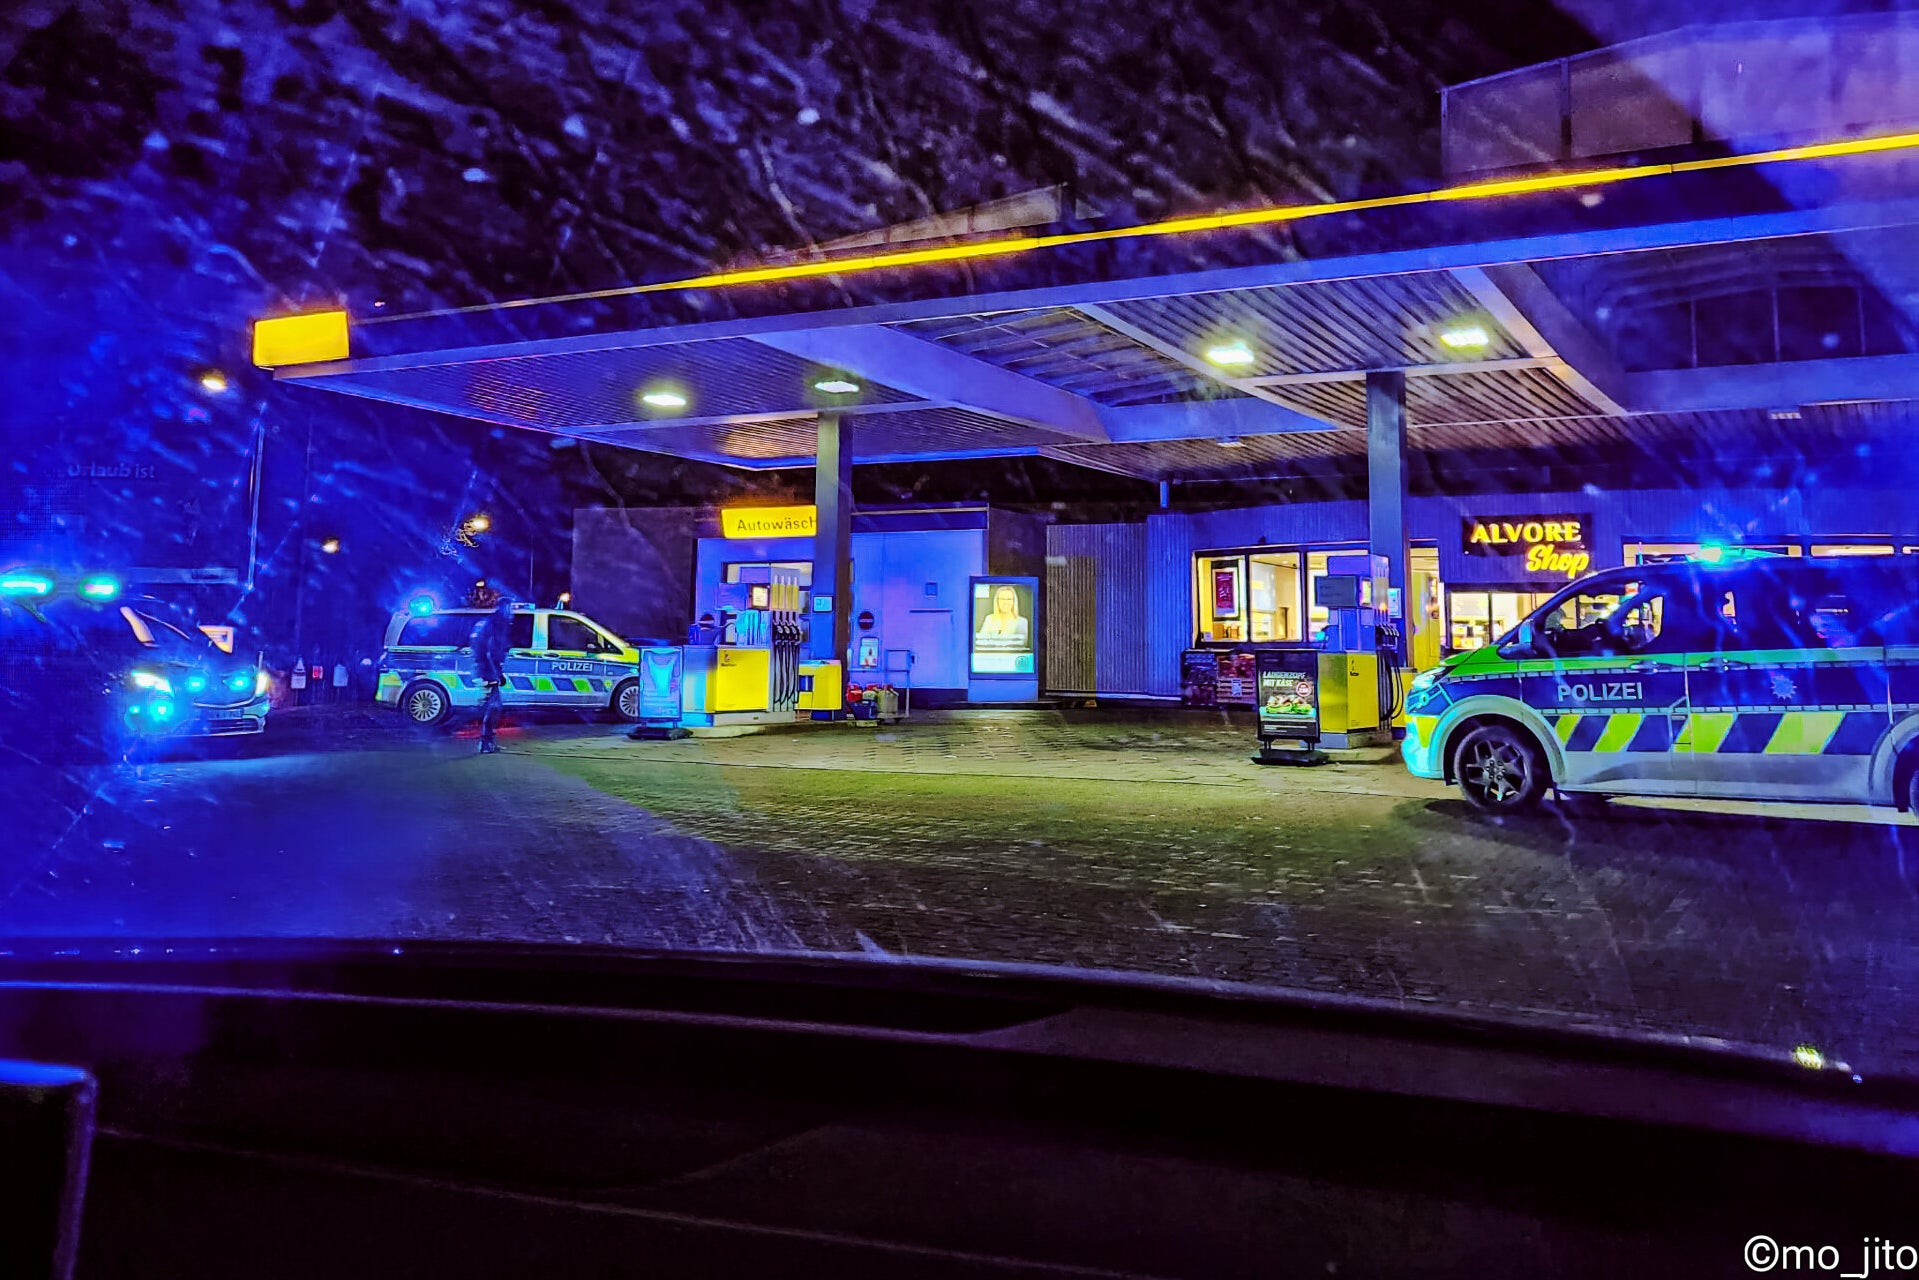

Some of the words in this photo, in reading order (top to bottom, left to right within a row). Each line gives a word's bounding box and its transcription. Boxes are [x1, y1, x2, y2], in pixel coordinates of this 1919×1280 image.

[1470, 521, 1582, 544] ALVORE
[1525, 544, 1590, 580] Shop
[552, 661, 593, 671] POLIZEI
[1557, 682, 1643, 702] POLIZEI
